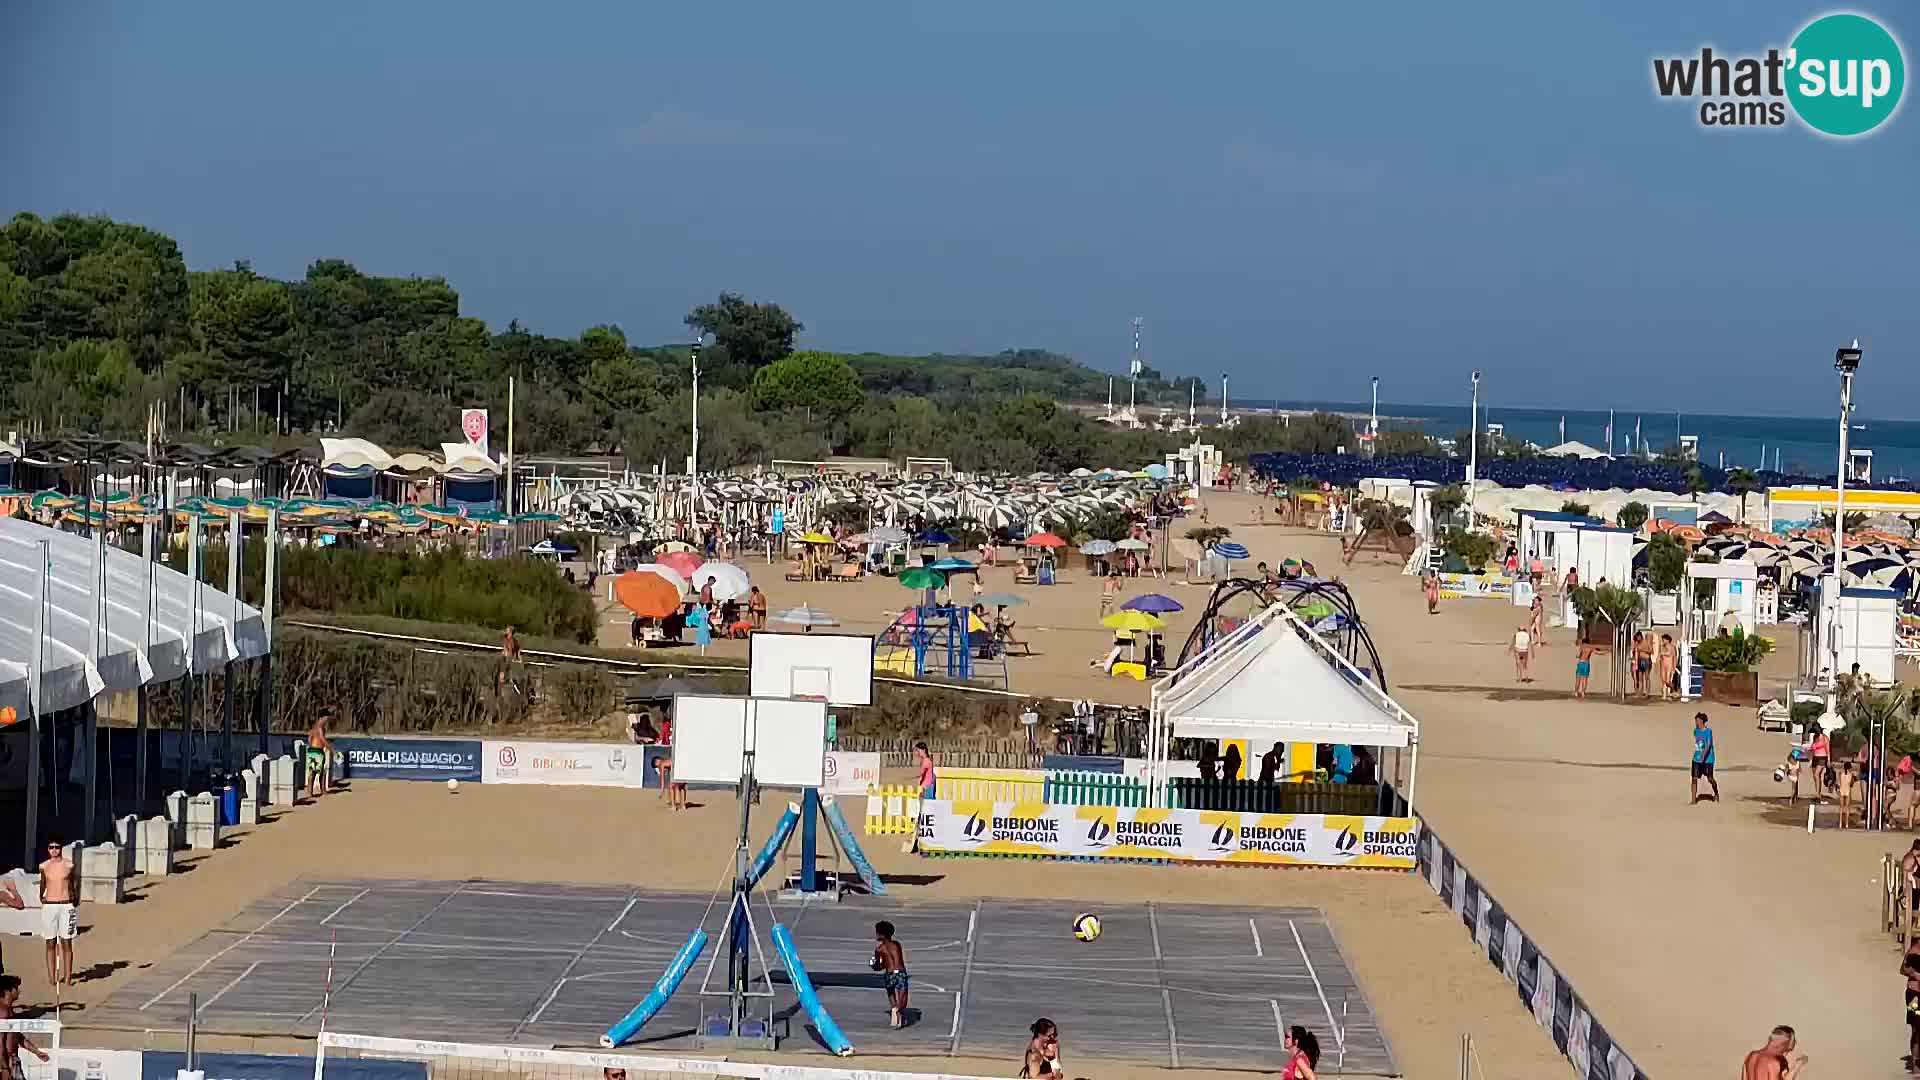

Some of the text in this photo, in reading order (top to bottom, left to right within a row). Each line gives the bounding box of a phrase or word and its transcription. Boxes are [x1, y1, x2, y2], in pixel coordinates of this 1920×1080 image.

[993, 817, 1058, 831] BIBIONE
[1116, 821, 1182, 836] BIBIONE
[992, 830, 1058, 843] SPIAGGIA
[1240, 826, 1306, 841] BIBIONE
[1116, 834, 1182, 848] SPIAGGIA
[1240, 840, 1305, 853] SPIAGGIA
